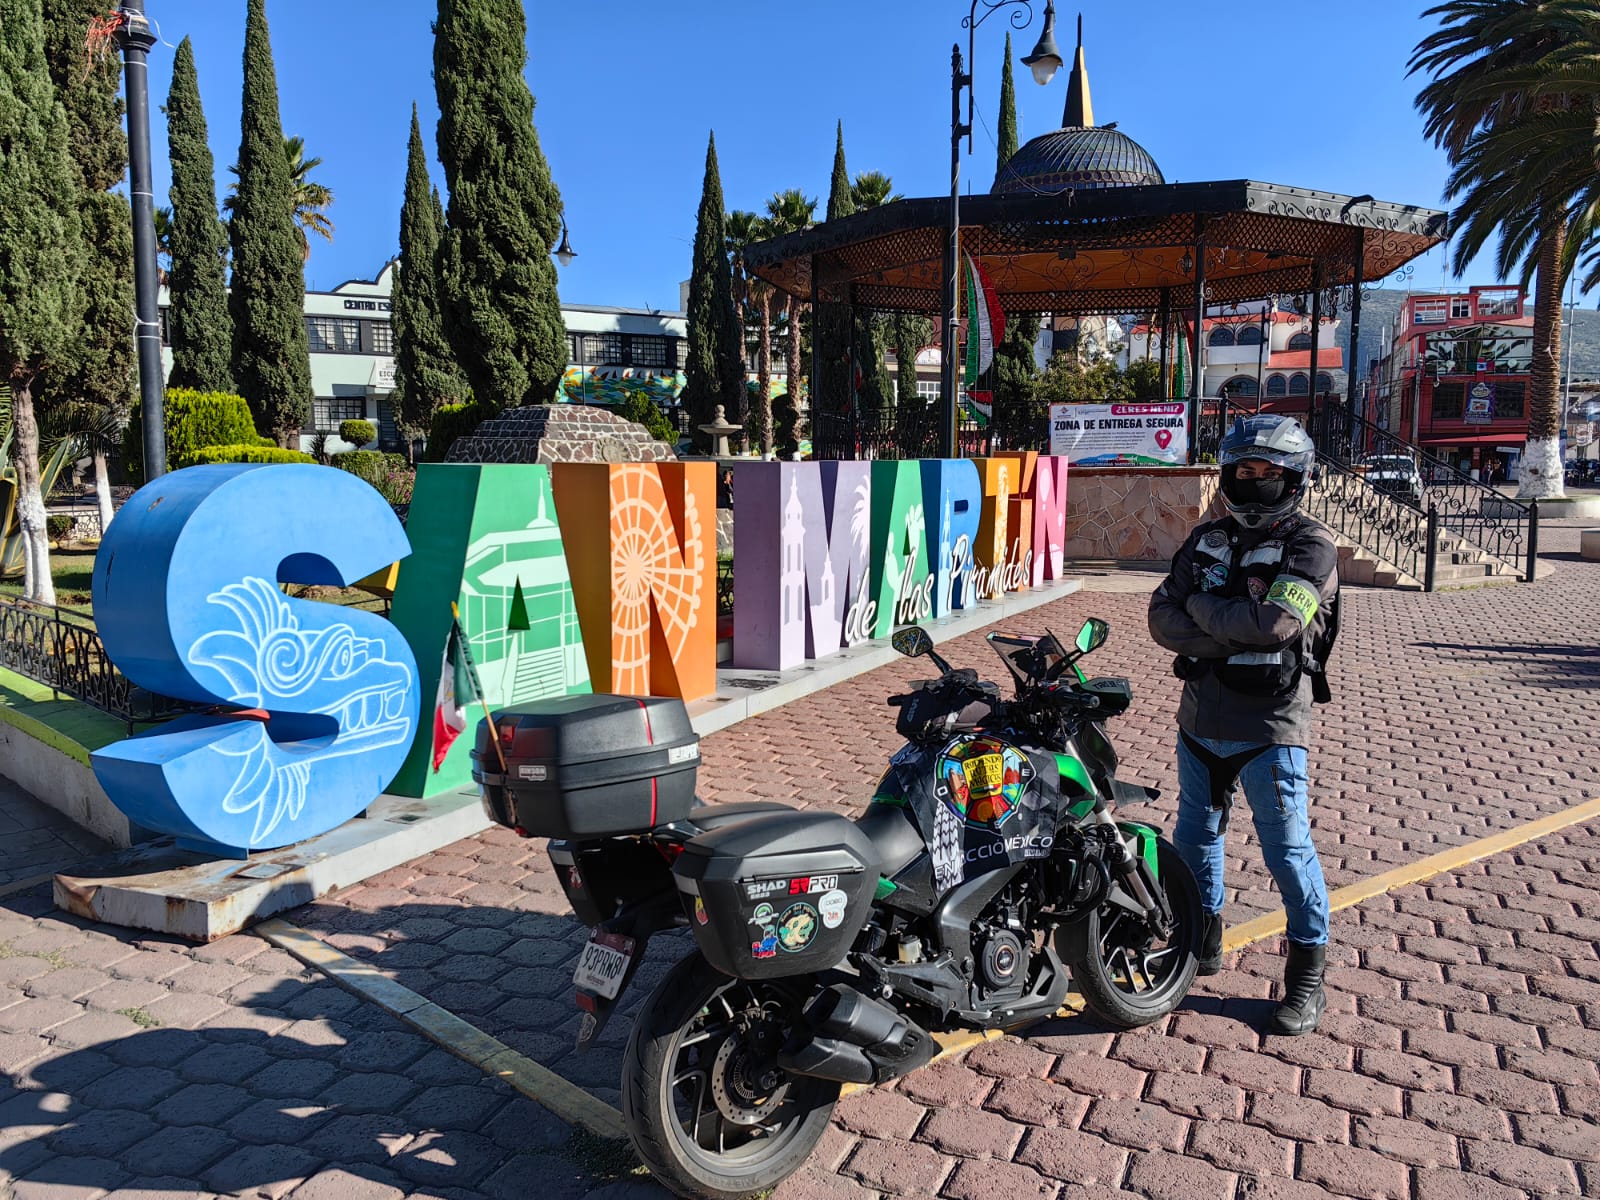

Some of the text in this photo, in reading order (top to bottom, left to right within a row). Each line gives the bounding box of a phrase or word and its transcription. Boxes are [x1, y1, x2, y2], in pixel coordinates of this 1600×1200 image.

[1054, 417, 1184, 431] ZONA DE ENTREGA SEGURA
[845, 568, 881, 644] de
[898, 547, 935, 626] las
[92, 450, 1069, 852] SAN MARTÍN
[747, 880, 787, 895] SHAD
